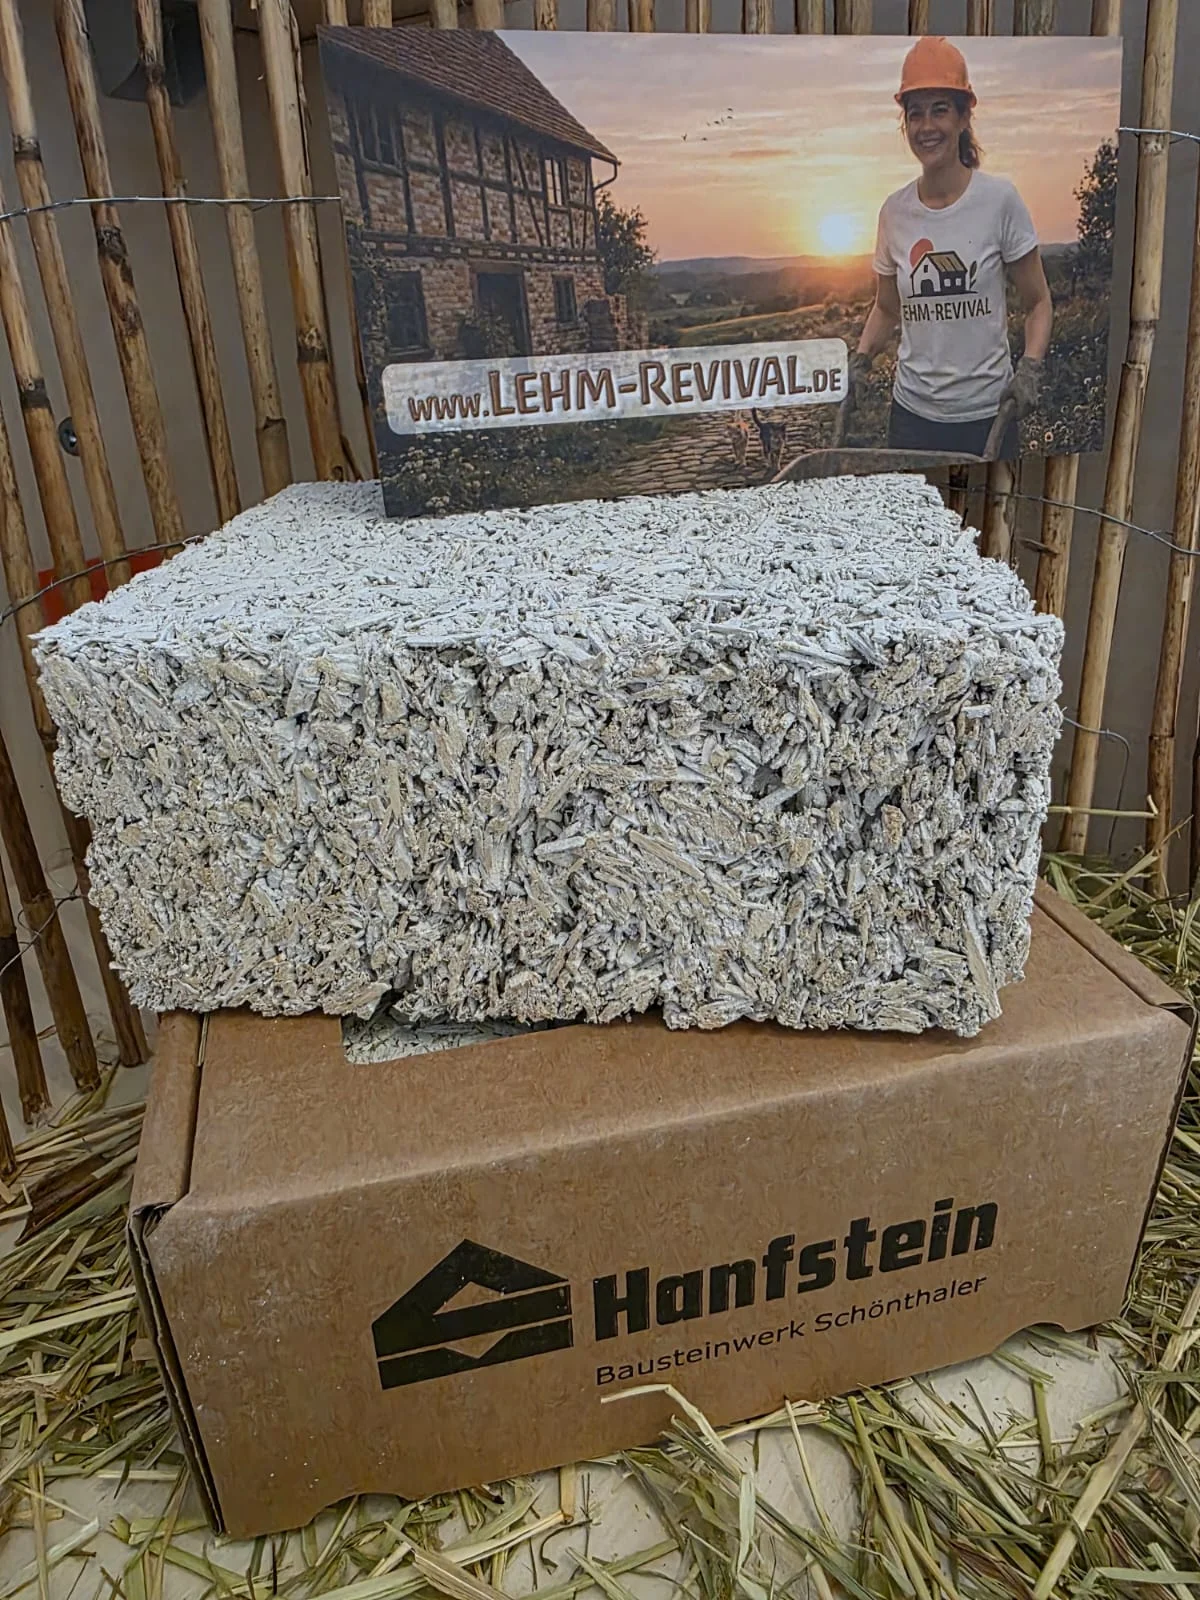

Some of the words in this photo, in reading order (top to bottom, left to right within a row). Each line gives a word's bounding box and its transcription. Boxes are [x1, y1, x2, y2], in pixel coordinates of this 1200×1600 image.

[902, 296, 991, 322] EHM-REVIVAL
[593, 1197, 998, 1341] Hanfstein
[596, 1319, 805, 1385] Bausteinwerk
[814, 1275, 988, 1332] Schönthaler
